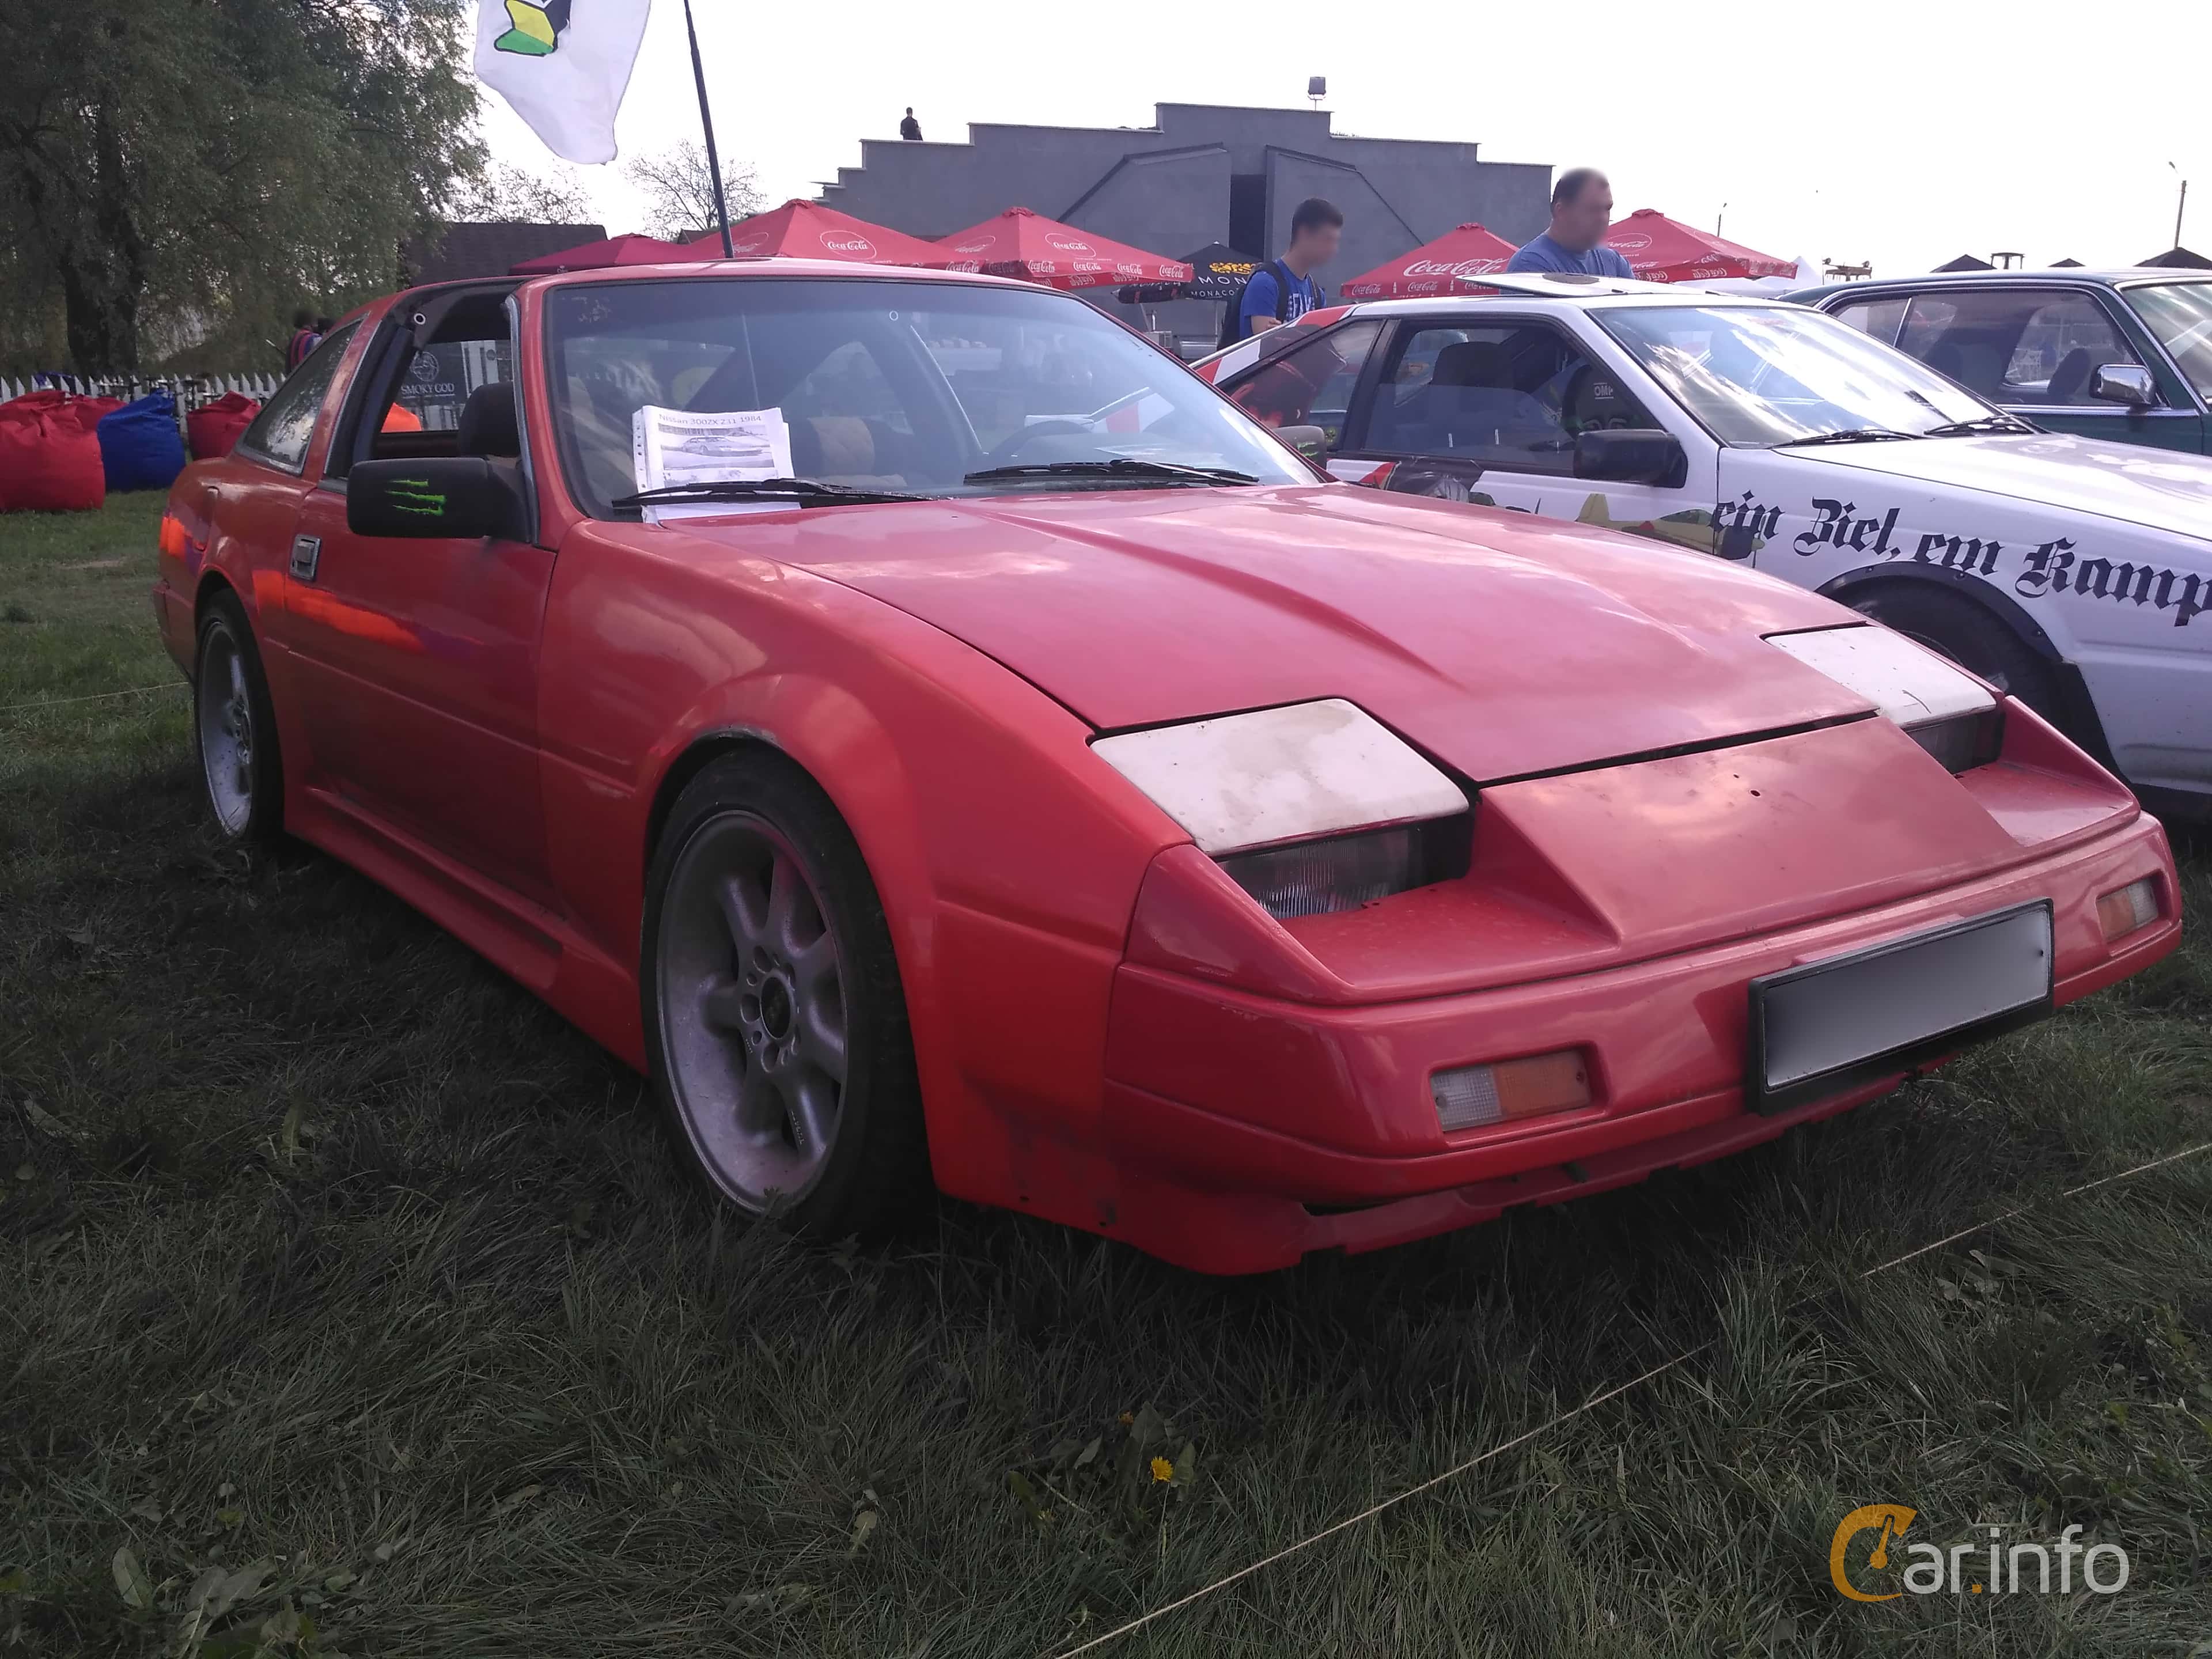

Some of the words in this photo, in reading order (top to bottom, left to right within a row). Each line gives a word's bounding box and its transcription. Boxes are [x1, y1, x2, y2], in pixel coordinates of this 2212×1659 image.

[827, 240, 868, 250] Coca-Cola
[1028, 260, 1055, 273] Coca-Cola
[1117, 263, 1142, 275] Coca-Cola
[1160, 265, 1184, 278] Coca-Cola
[1352, 283, 1381, 295] Coca-Cola
[1408, 281, 1438, 291] Coca-Cola
[659, 413, 688, 425] Nissan
[740, 415, 762, 423] 1984
